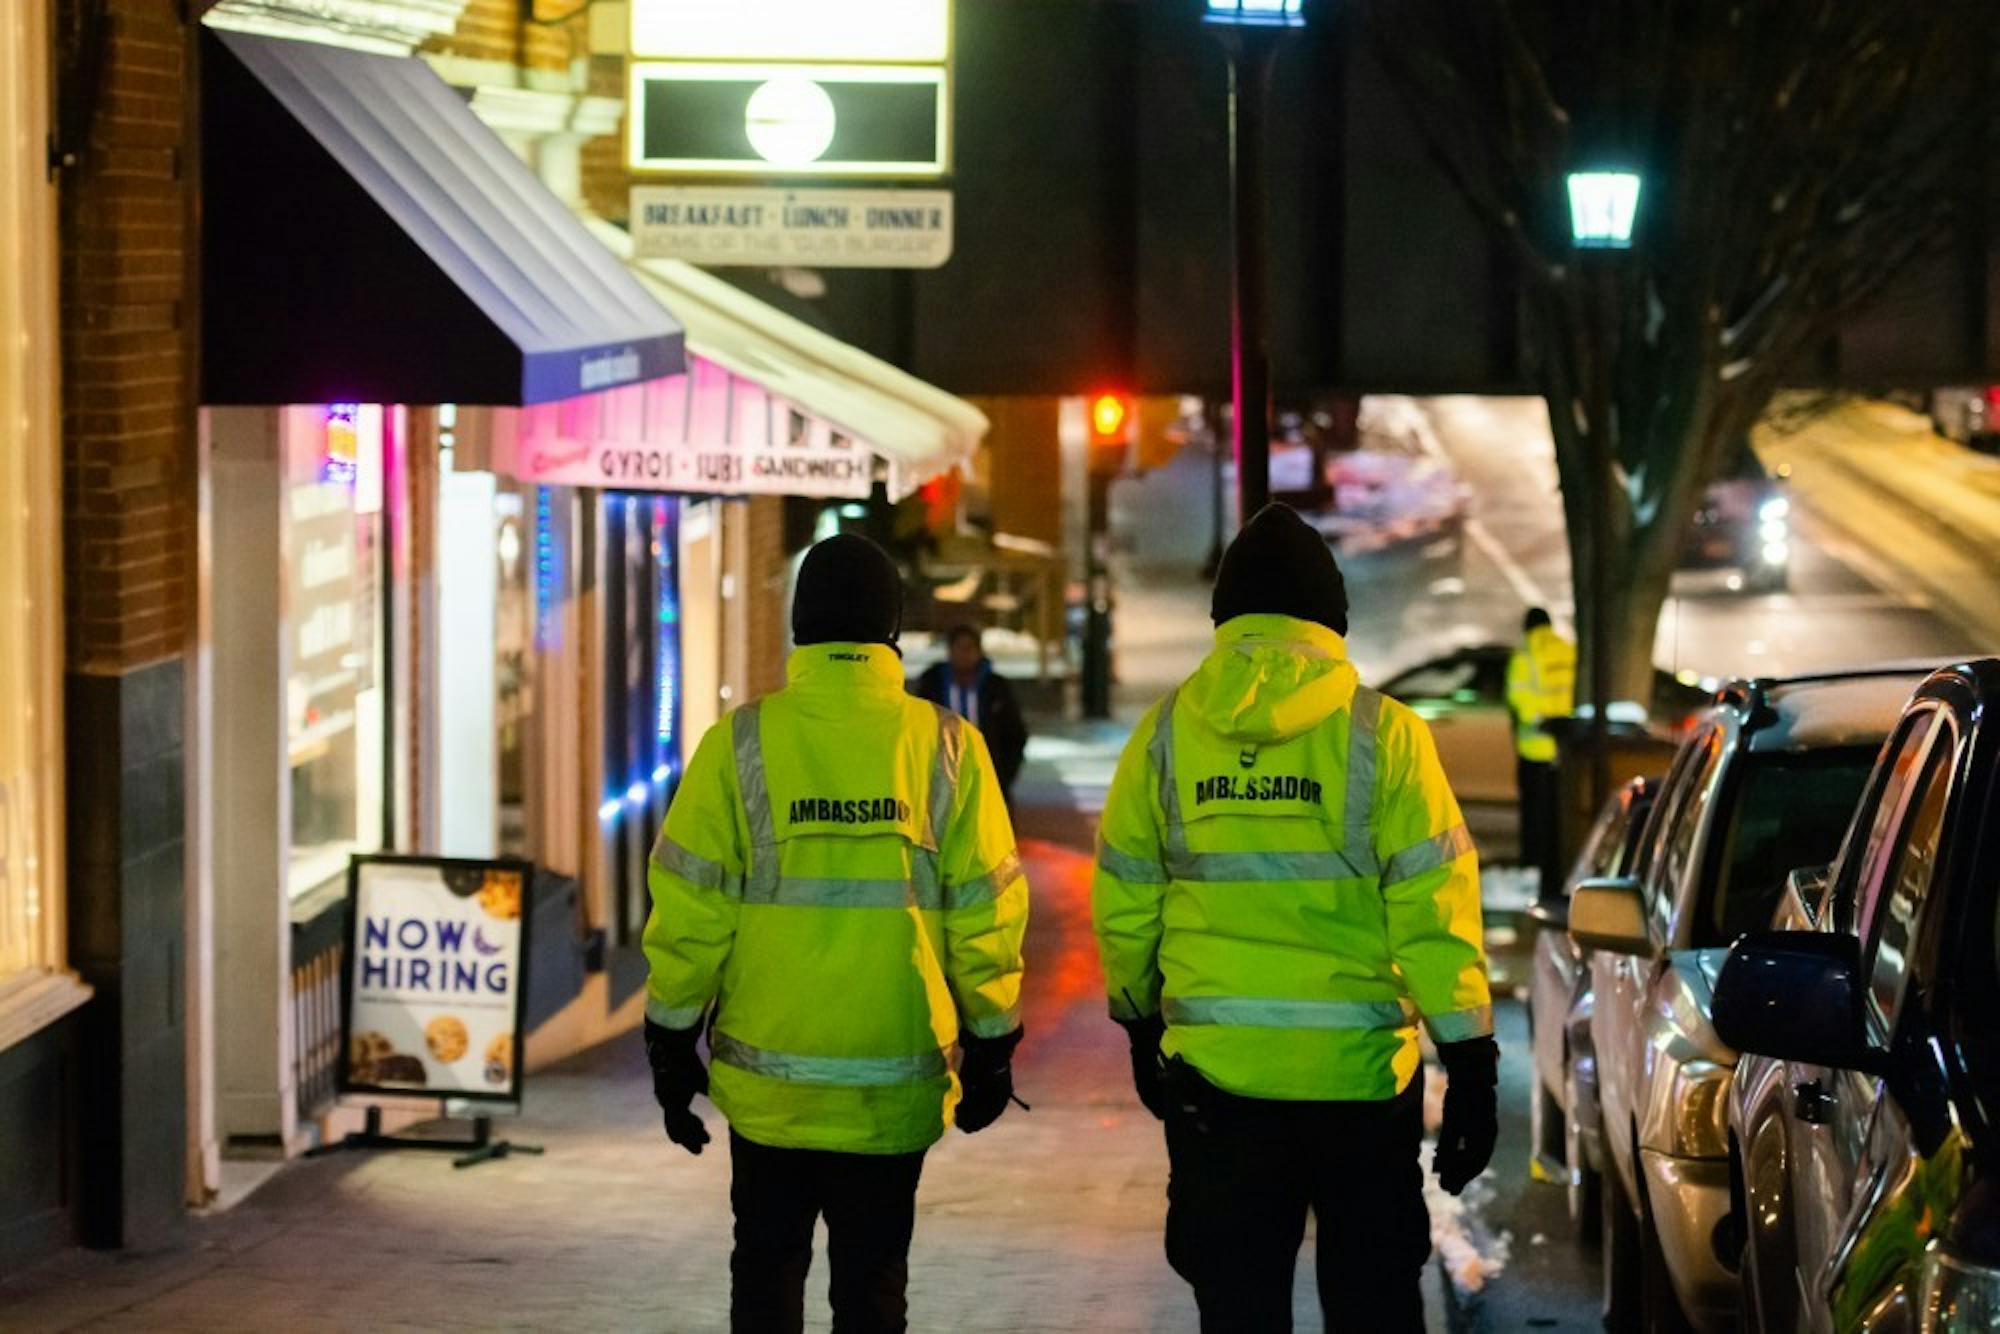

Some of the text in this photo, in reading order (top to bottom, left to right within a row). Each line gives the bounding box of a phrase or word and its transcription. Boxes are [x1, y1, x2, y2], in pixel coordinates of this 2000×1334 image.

[645, 203, 943, 230] BREAKFAST LUNCH DINNER
[599, 450, 673, 479] GYROS
[696, 453, 743, 481] SUBS
[365, 917, 467, 952] NOW
[361, 957, 508, 992] HIRING
